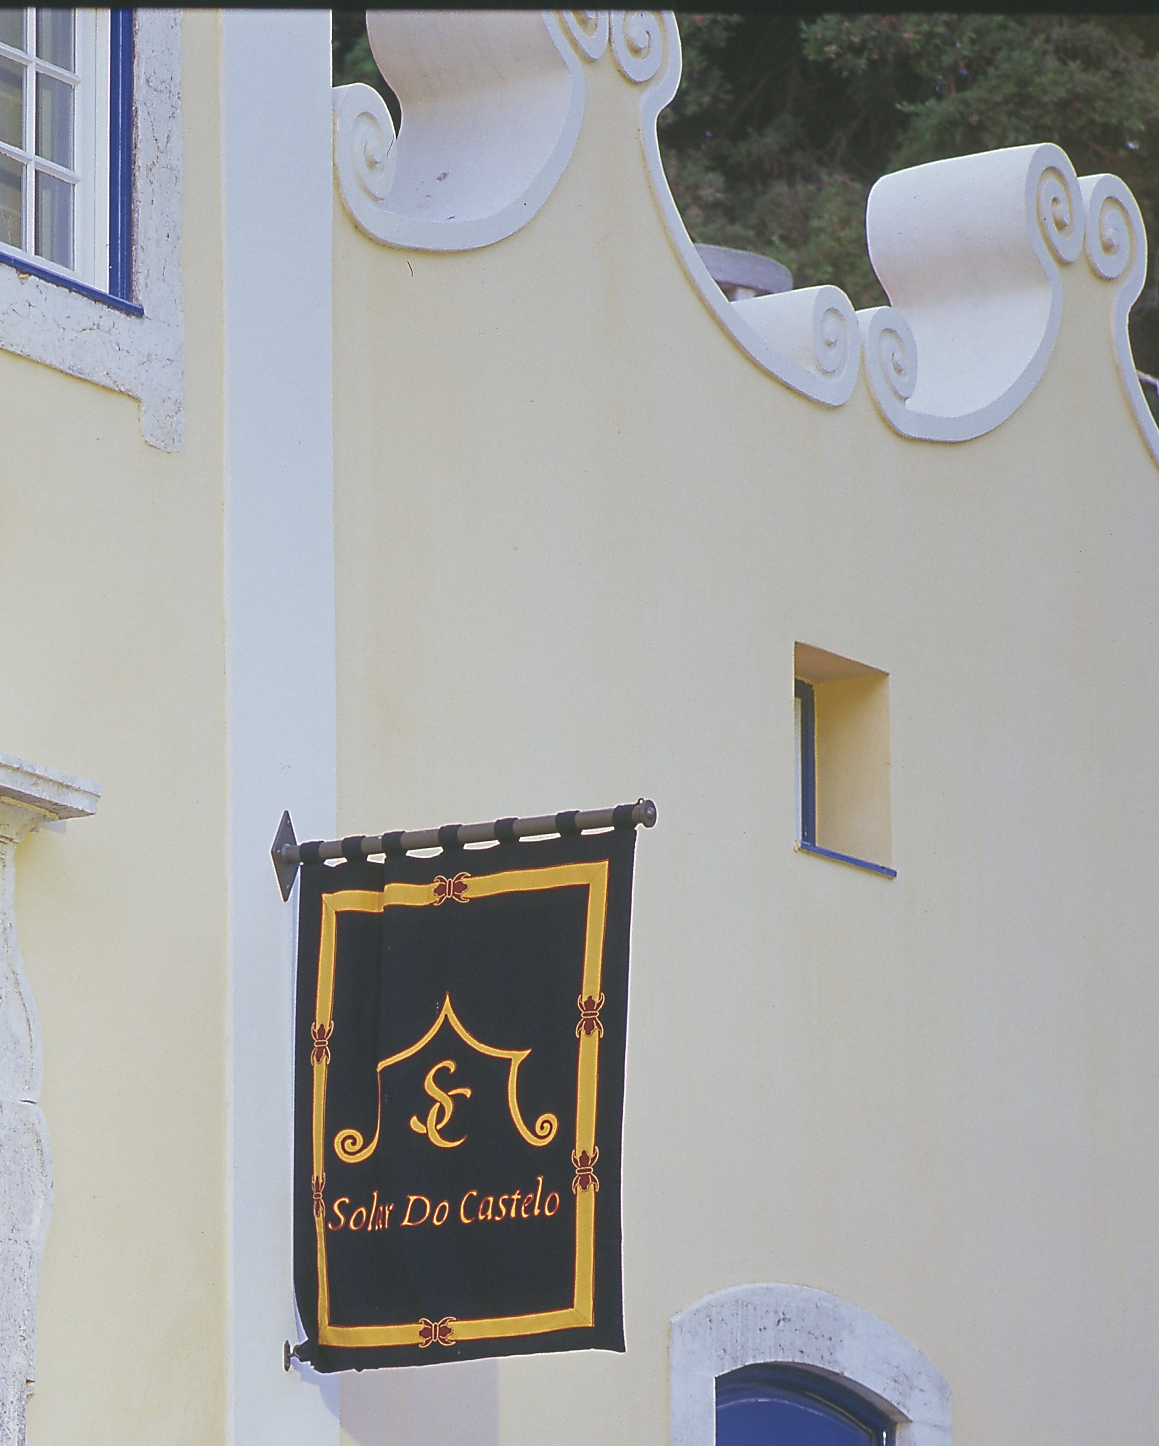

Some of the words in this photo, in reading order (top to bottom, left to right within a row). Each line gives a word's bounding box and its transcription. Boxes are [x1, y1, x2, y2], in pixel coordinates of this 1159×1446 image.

[328, 1191, 394, 1232] Solar
[400, 1195, 450, 1226] Do
[459, 1176, 560, 1224] Castelo
